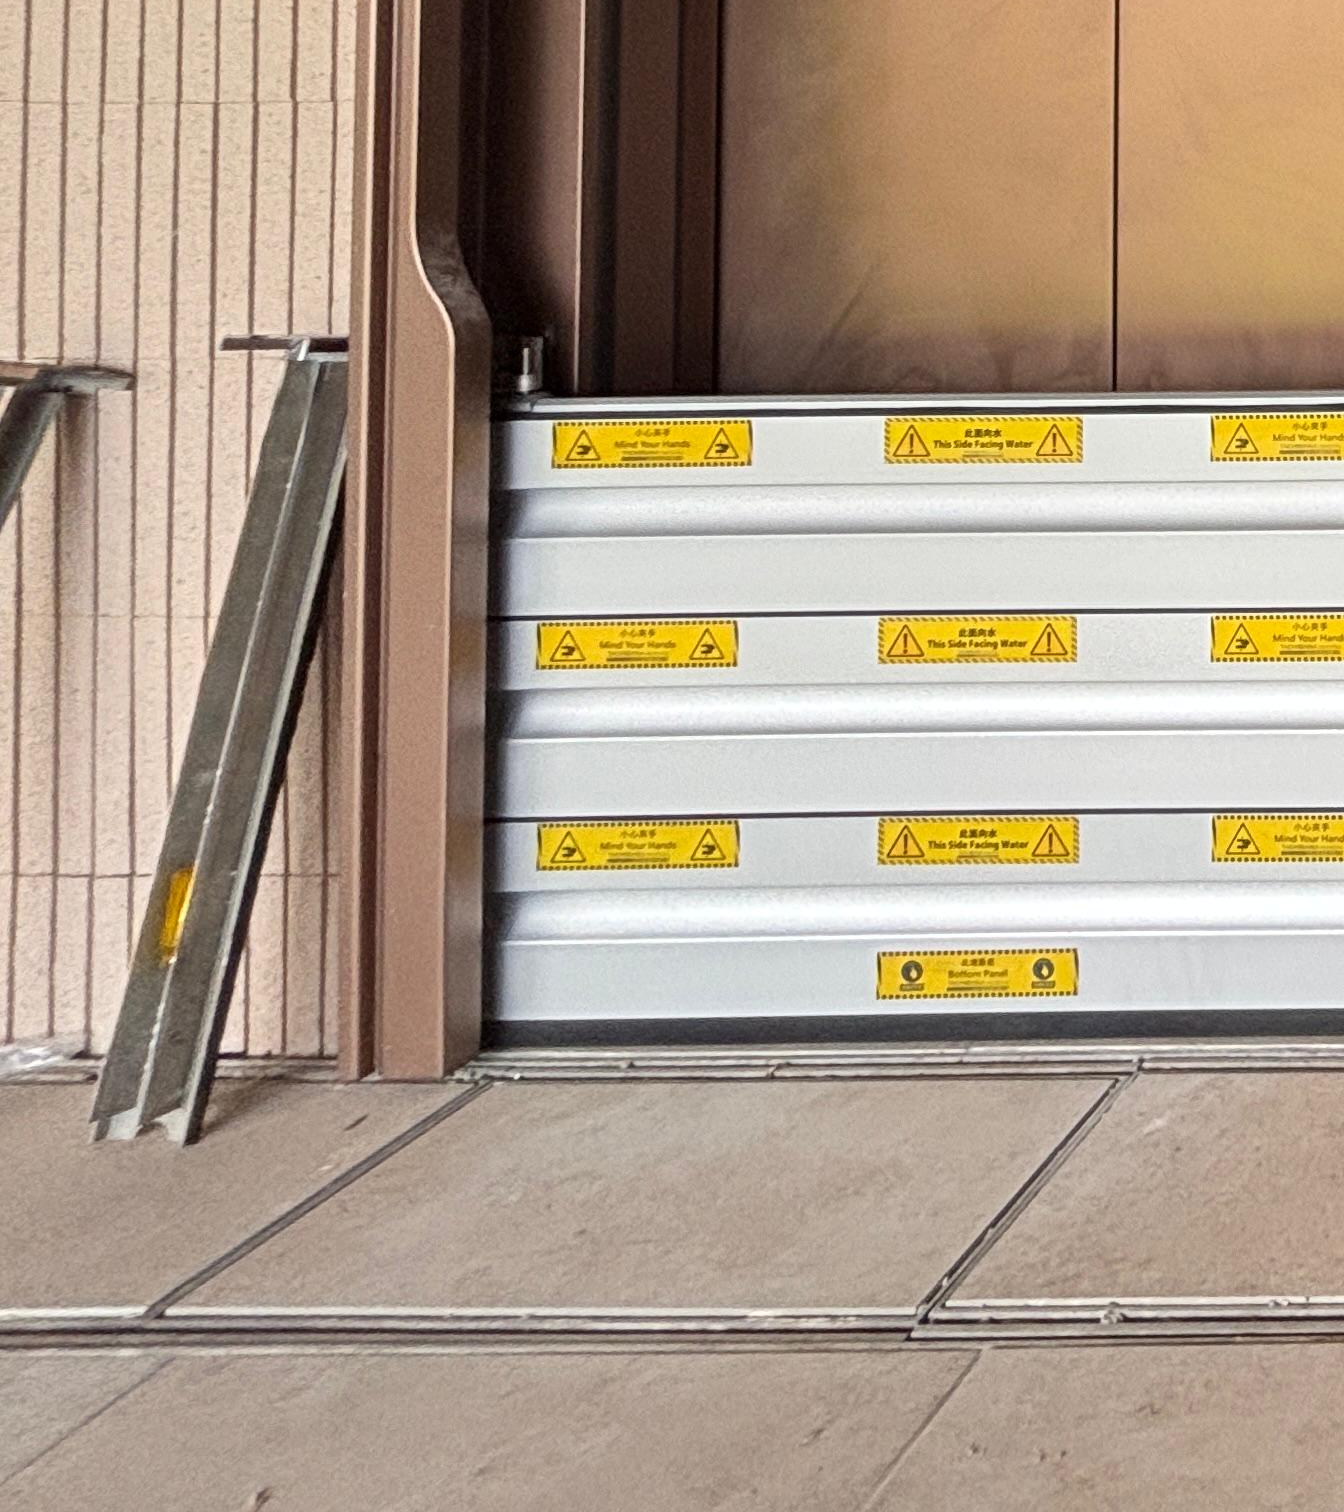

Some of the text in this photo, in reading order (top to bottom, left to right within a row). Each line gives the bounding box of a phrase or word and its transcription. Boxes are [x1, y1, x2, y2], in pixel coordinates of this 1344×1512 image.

[1273, 434, 1295, 442] Mind
[1298, 434, 1317, 442] Your
[934, 440, 1033, 450] This Side Facing Water
[1273, 634, 1295, 642] Mind
[1298, 634, 1317, 642] Your
[599, 641, 622, 649] Mind
[649, 641, 676, 649] Hands
[928, 640, 1027, 649] This Side Facing Water
[600, 841, 623, 849] Mind
[649, 841, 677, 849] Hands
[929, 841, 1028, 850] This Side Facing Water
[983, 970, 1008, 978] Panel
